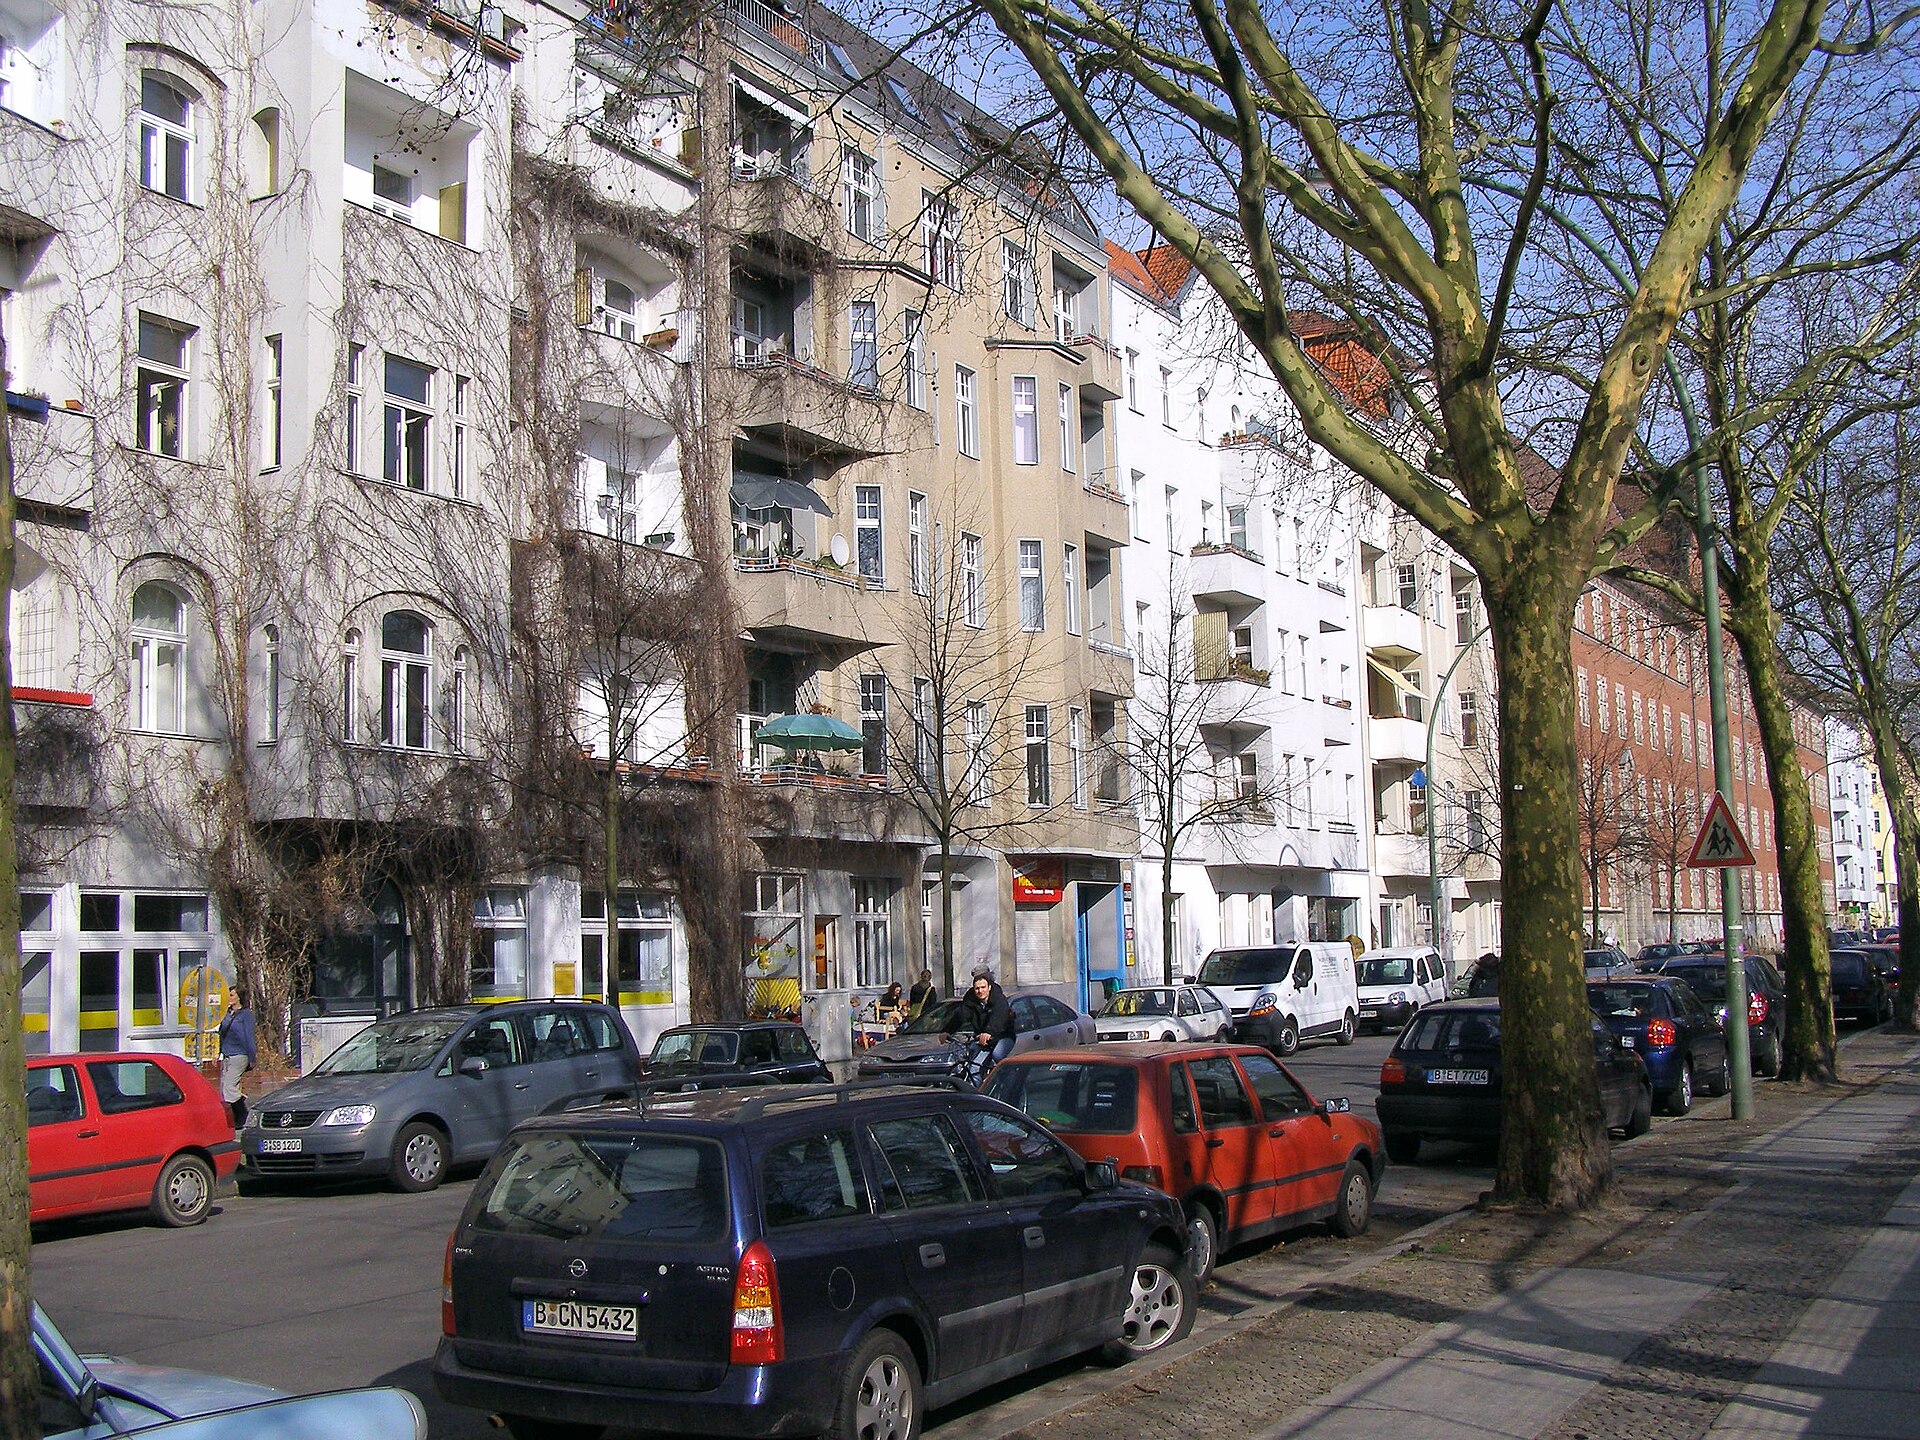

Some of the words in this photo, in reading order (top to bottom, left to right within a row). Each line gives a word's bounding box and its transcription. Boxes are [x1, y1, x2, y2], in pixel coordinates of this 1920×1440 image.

[696, 1265, 730, 1273] ASTRA
[535, 1302, 547, 1324] B
[559, 1304, 583, 1327] CN
[586, 1306, 635, 1332] 5432
